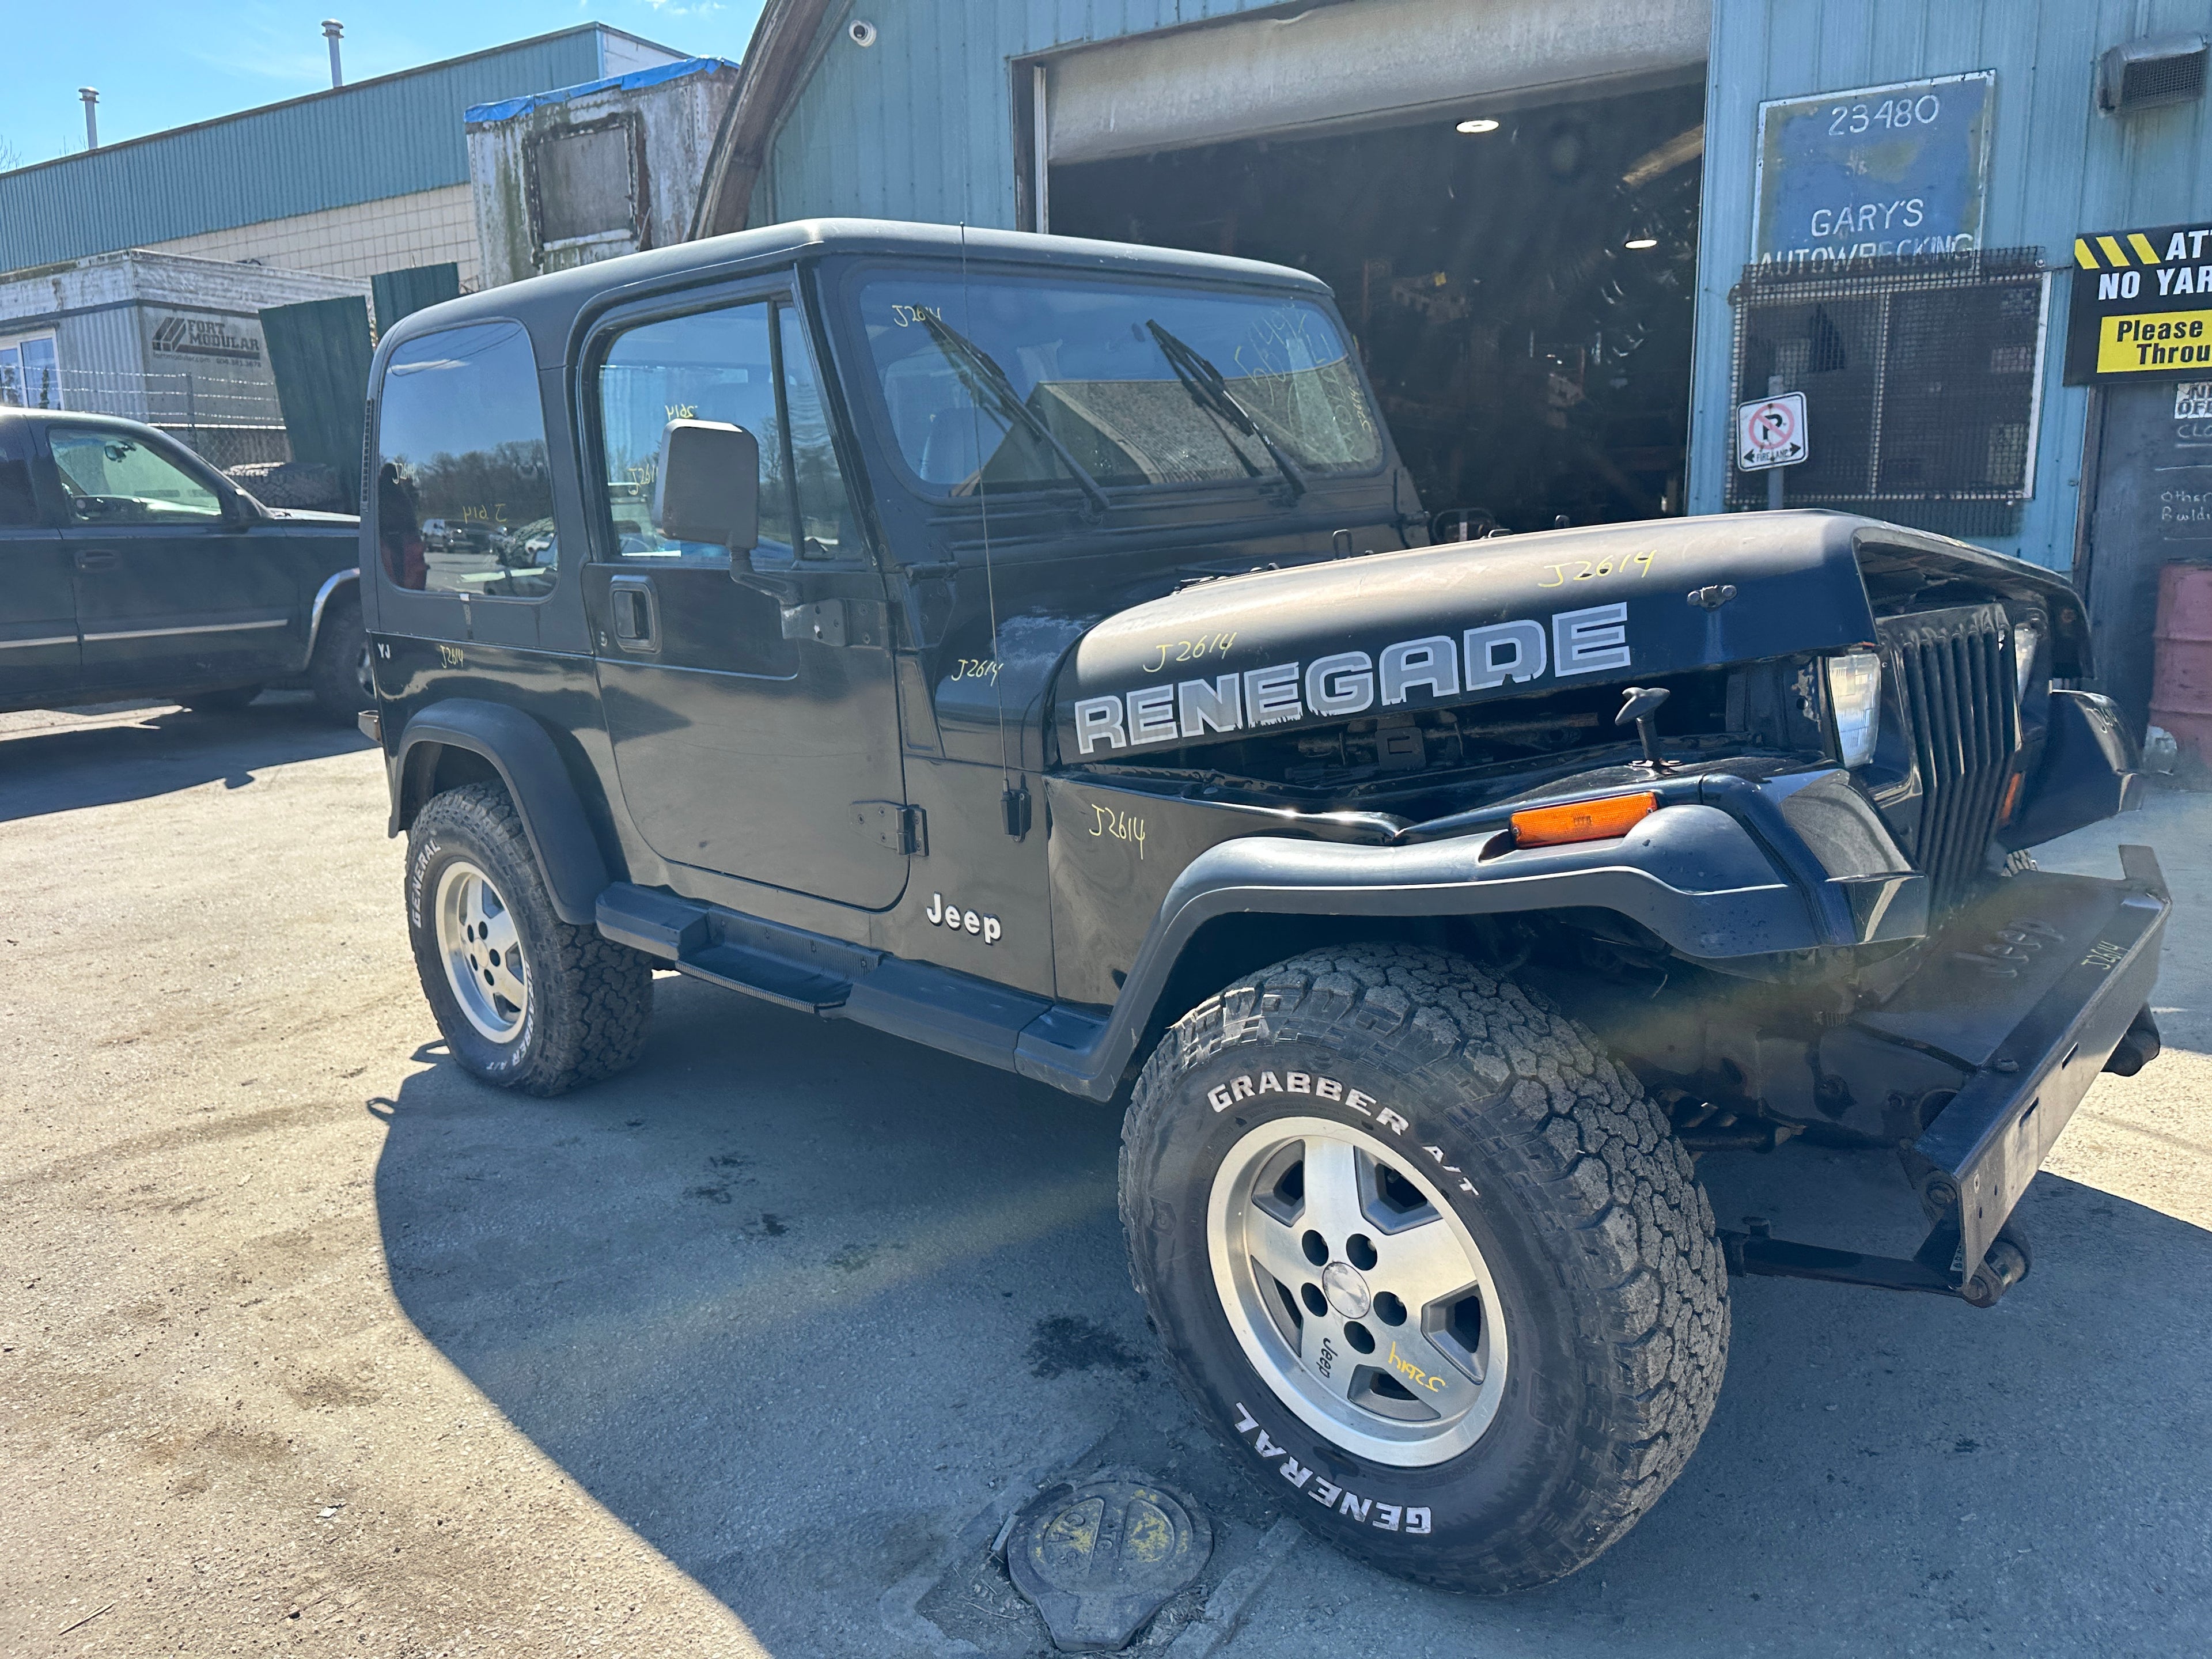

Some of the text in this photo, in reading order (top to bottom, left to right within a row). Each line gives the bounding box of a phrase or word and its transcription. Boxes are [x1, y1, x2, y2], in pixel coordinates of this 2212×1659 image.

[1828, 94, 1940, 136] 23480
[1811, 198, 1924, 237] GARY'S
[2165, 230, 2212, 261] AT
[2098, 265, 2212, 301] NO YAR
[187, 319, 225, 335] FORT
[892, 305, 942, 327] J264
[2116, 320, 2204, 342] Please
[189, 332, 260, 350] MODULAR
[2136, 343, 2212, 365] Throu
[1756, 452, 1770, 461] FIRE
[628, 463, 659, 495] J261
[1538, 550, 1657, 588] J2614
[378, 643, 391, 659] YJ
[440, 645, 464, 669] J2614
[1143, 632, 1237, 672] J2614
[951, 659, 1004, 687] J2614
[1074, 601, 1631, 755] RENEGADE
[1089, 804, 1146, 860] J2614
[412, 838, 441, 929] GENERAL
[926, 892, 1002, 945] Jeep
[2081, 941, 2130, 969] J2614
[1207, 1071, 1480, 1196] GRABBER A/T
[1316, 1338, 1338, 1378] Jeep
[1234, 1402, 1431, 1534] GENERAL
